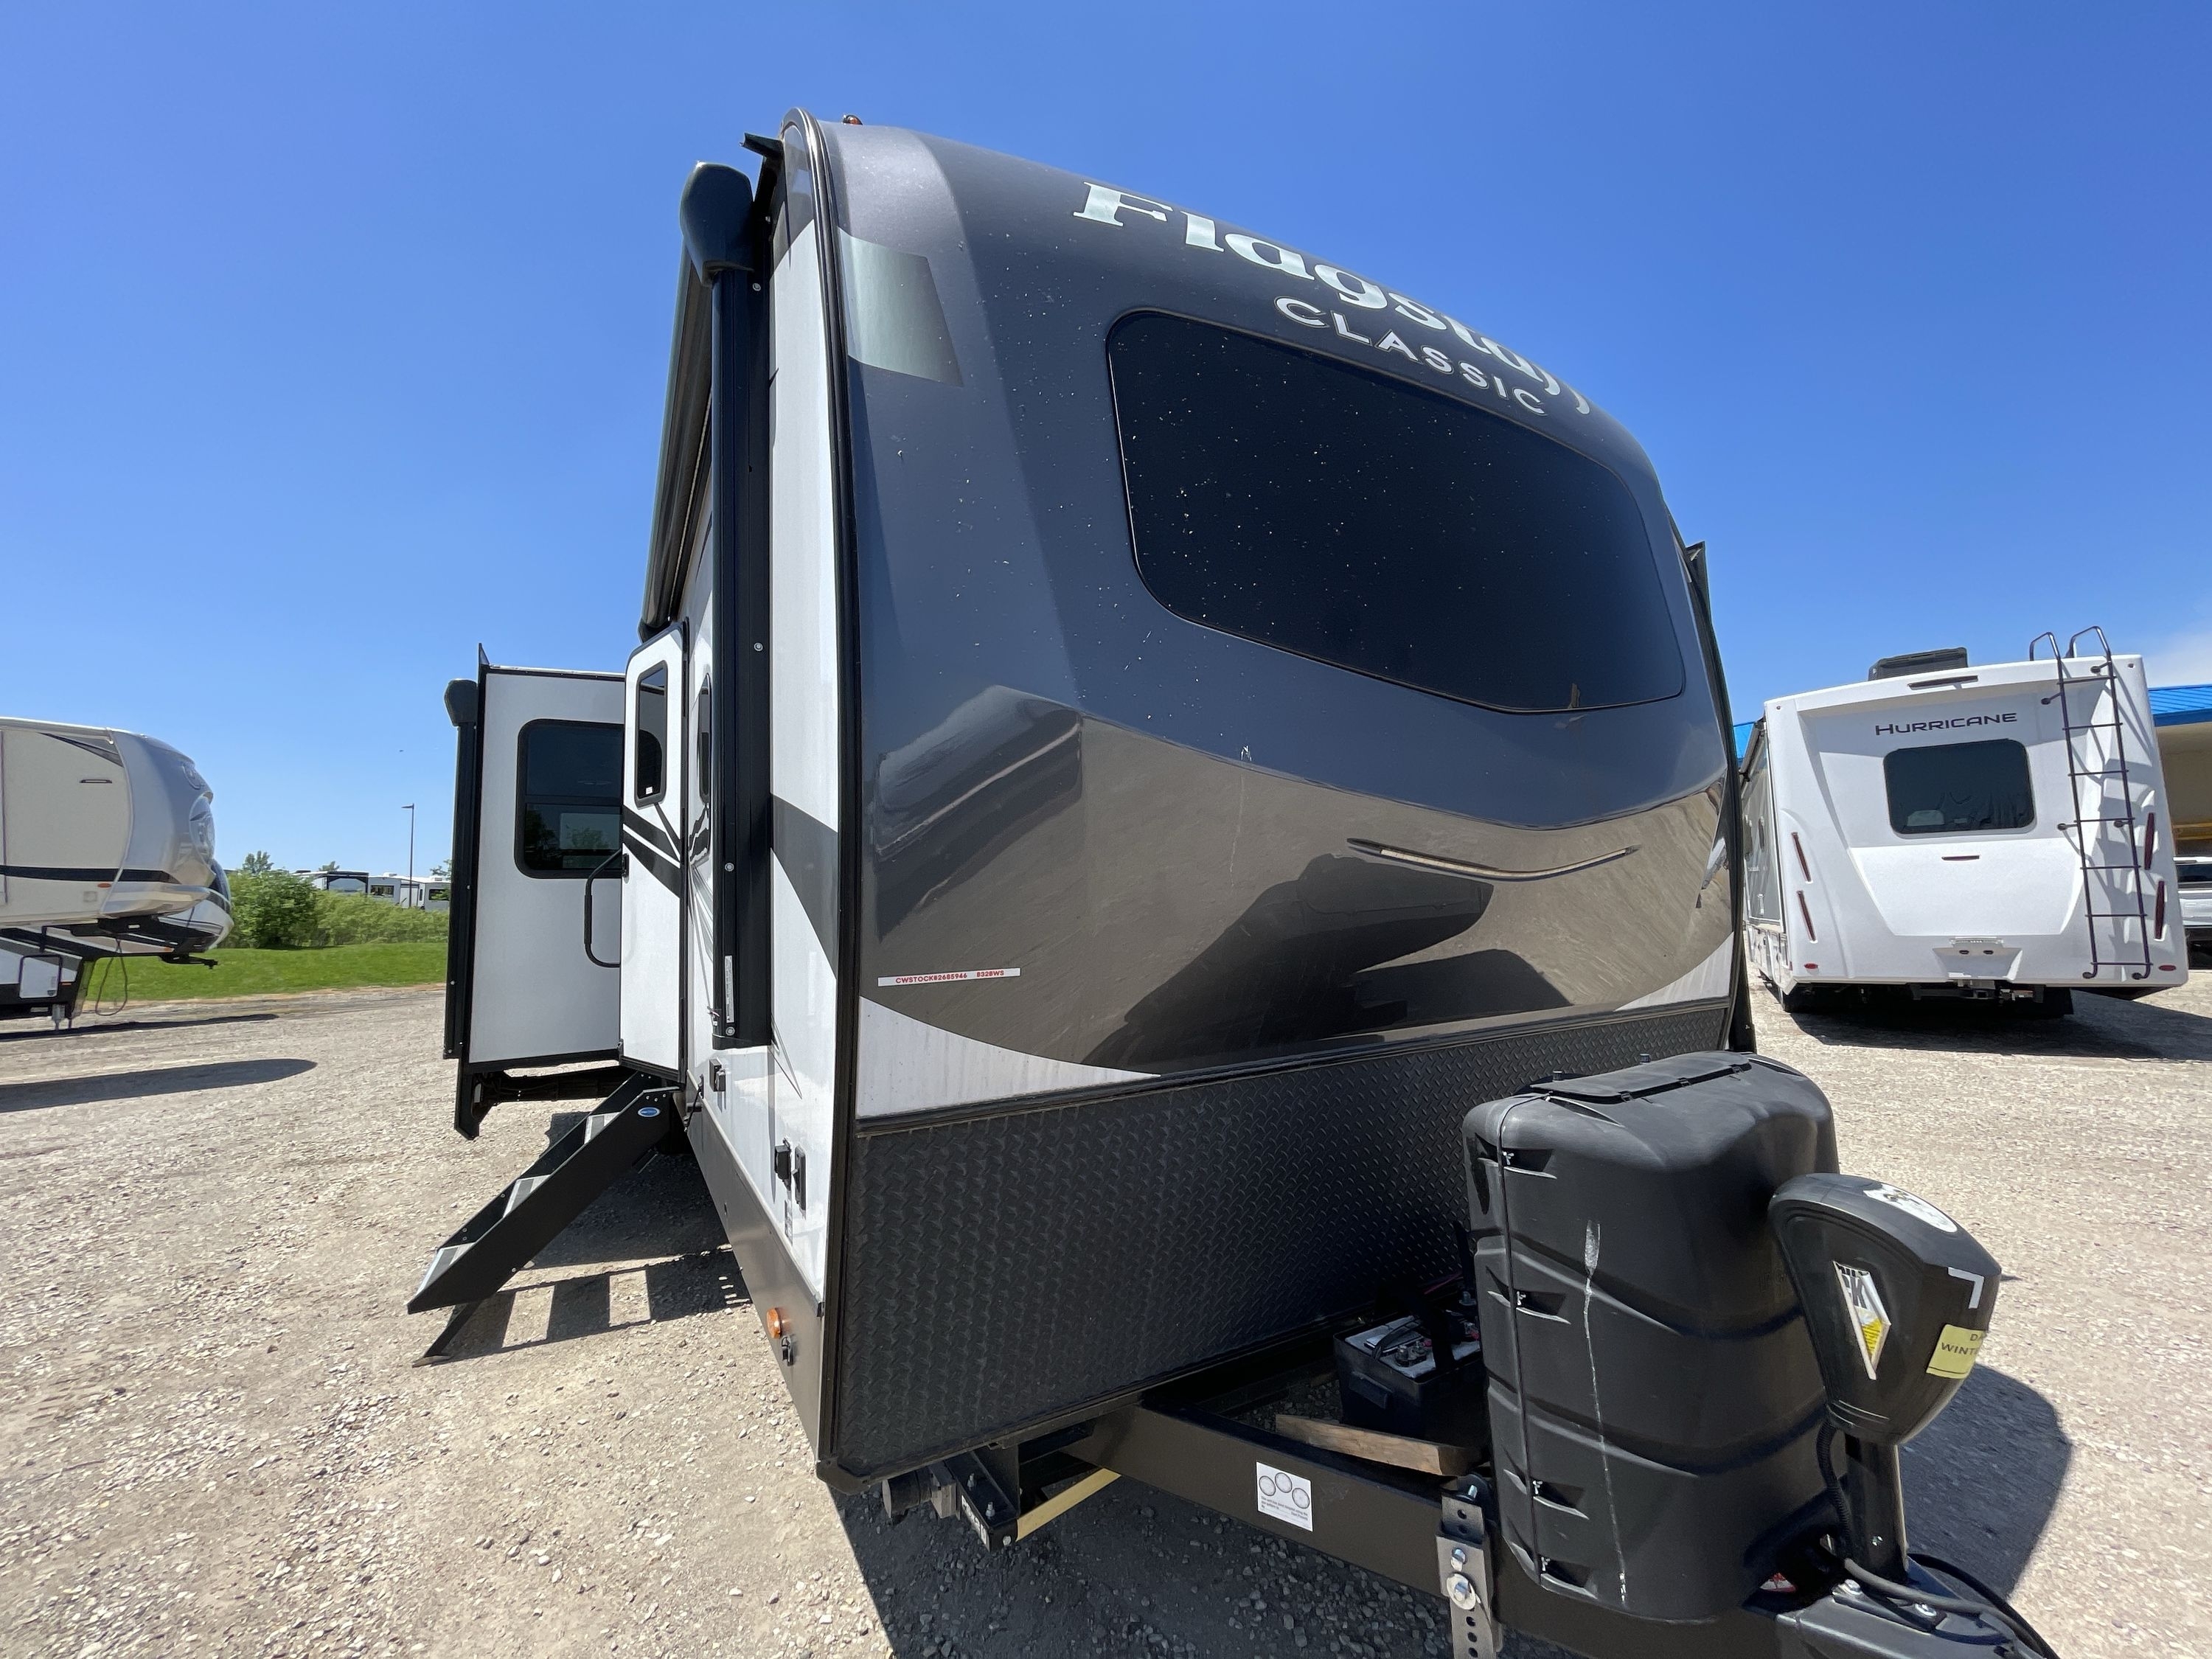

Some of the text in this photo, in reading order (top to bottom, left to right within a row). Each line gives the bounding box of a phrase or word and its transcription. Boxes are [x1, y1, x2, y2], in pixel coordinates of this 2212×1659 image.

[1273, 296, 1548, 416] CLASSIC
[1875, 712, 2017, 736] HURRICANE
[1941, 1342, 1978, 1355] WINT
